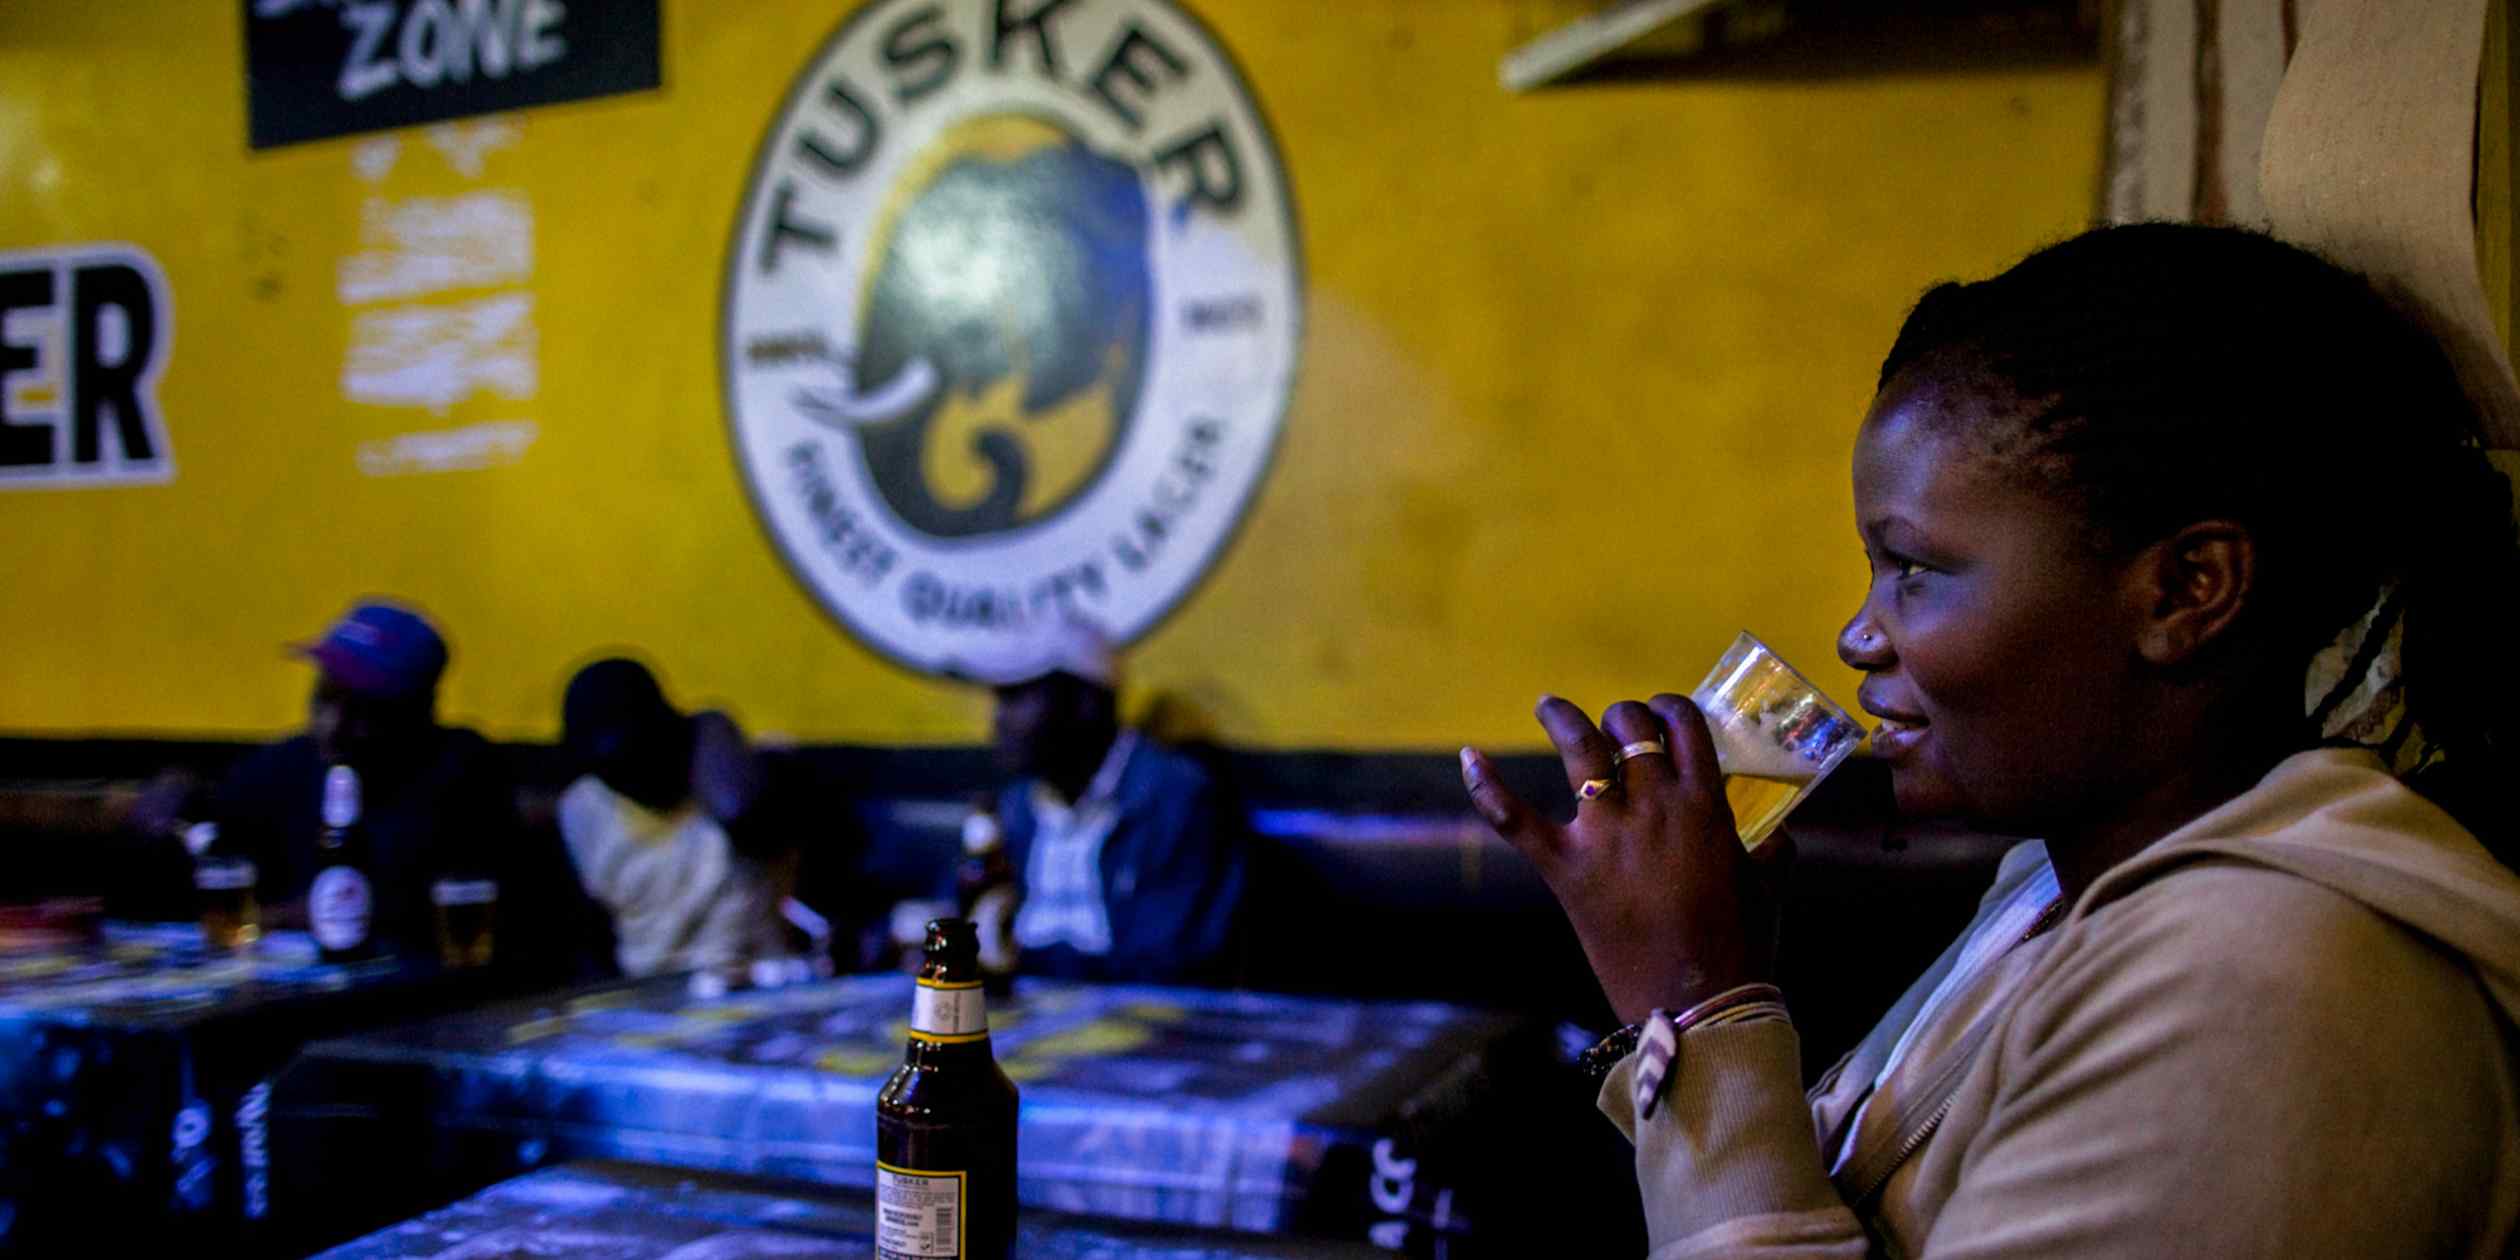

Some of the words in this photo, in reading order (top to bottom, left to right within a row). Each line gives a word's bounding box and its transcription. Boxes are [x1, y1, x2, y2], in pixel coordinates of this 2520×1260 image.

[337, 0, 566, 101] ZONE
[759, 0, 1246, 274] TUSKER
[0, 262, 157, 466] ER
